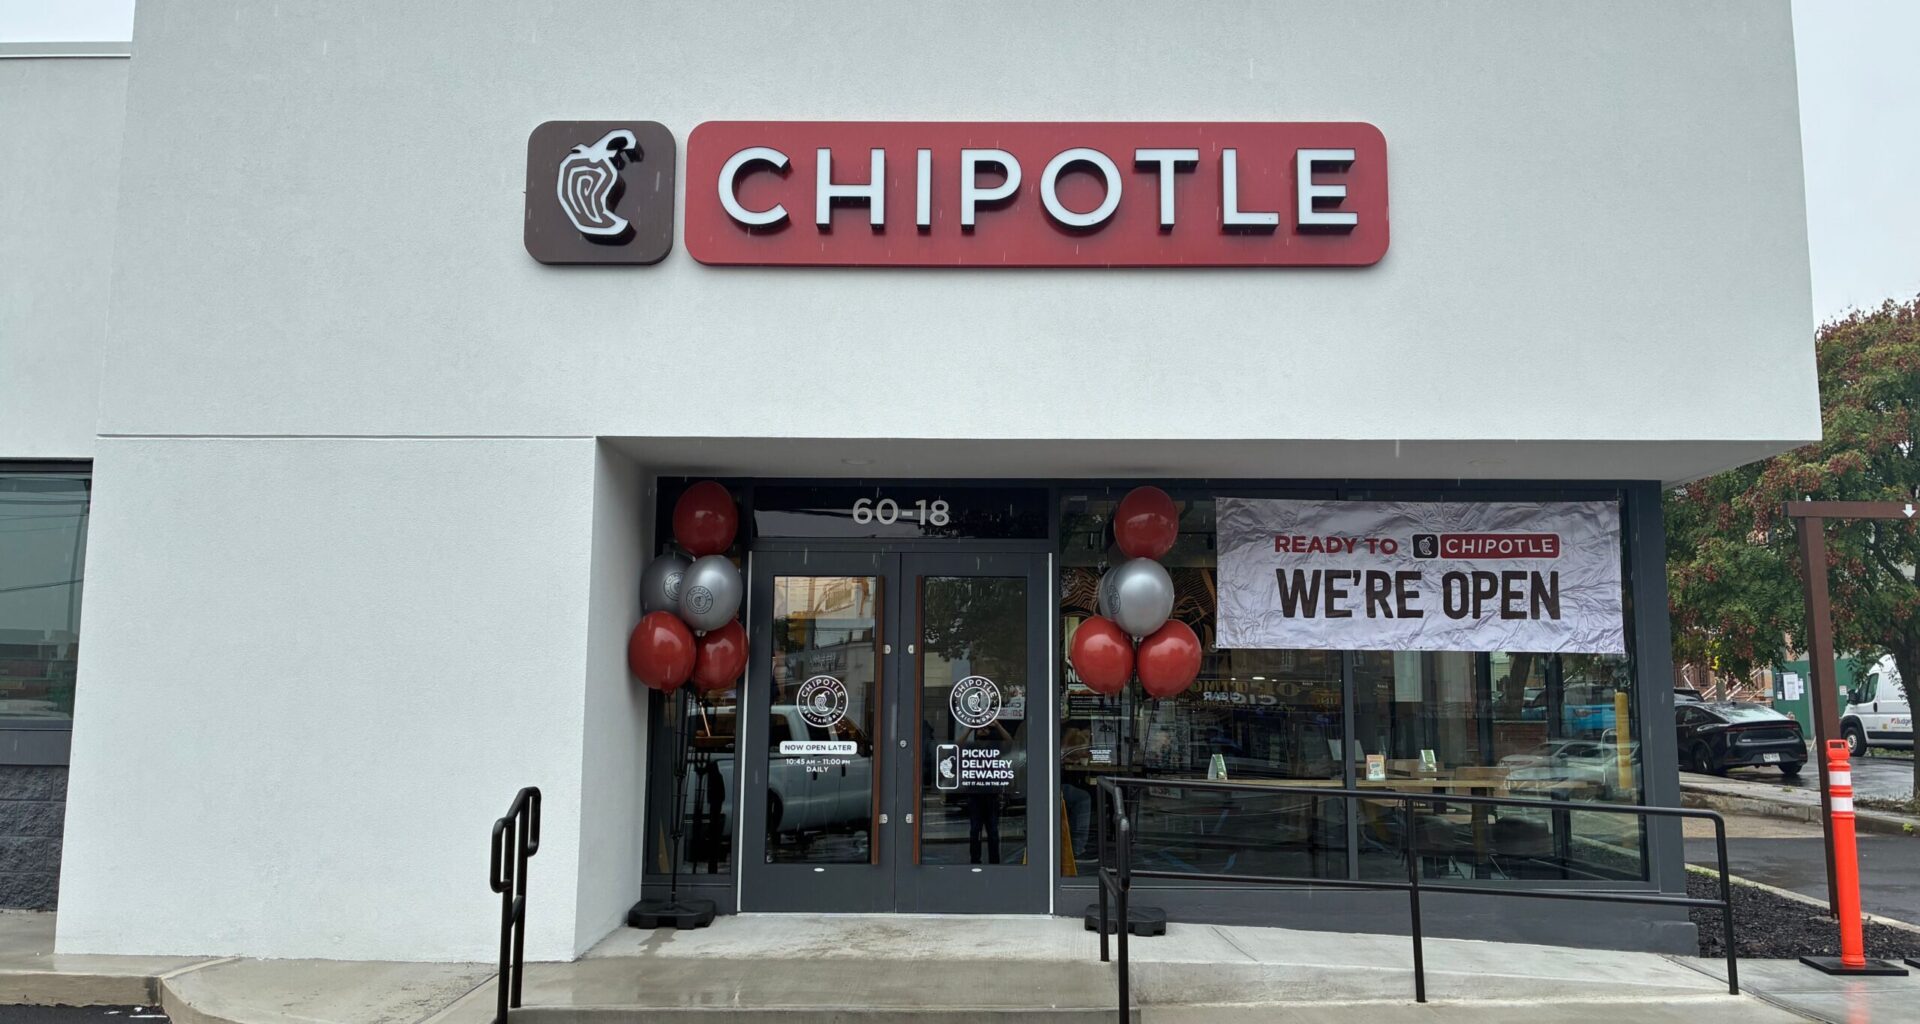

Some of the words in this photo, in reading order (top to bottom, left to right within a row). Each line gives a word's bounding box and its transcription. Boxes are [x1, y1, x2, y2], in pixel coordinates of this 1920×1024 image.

[717, 146, 1359, 229] CHIPOTLE
[852, 498, 950, 526] 60-18
[1274, 535, 1358, 554] READY
[1366, 538, 1398, 555] TO
[1445, 538, 1554, 554] CHIPOTLE
[1275, 568, 1424, 618] WE'RE
[1441, 570, 1561, 620] OPEN
[801, 678, 845, 699] CHIPOTLE
[954, 679, 998, 699] CHIPOTLE
[961, 749, 1000, 758] PICKUP
[961, 759, 1013, 768] DELIVERY
[961, 770, 1014, 779] REWARDS
